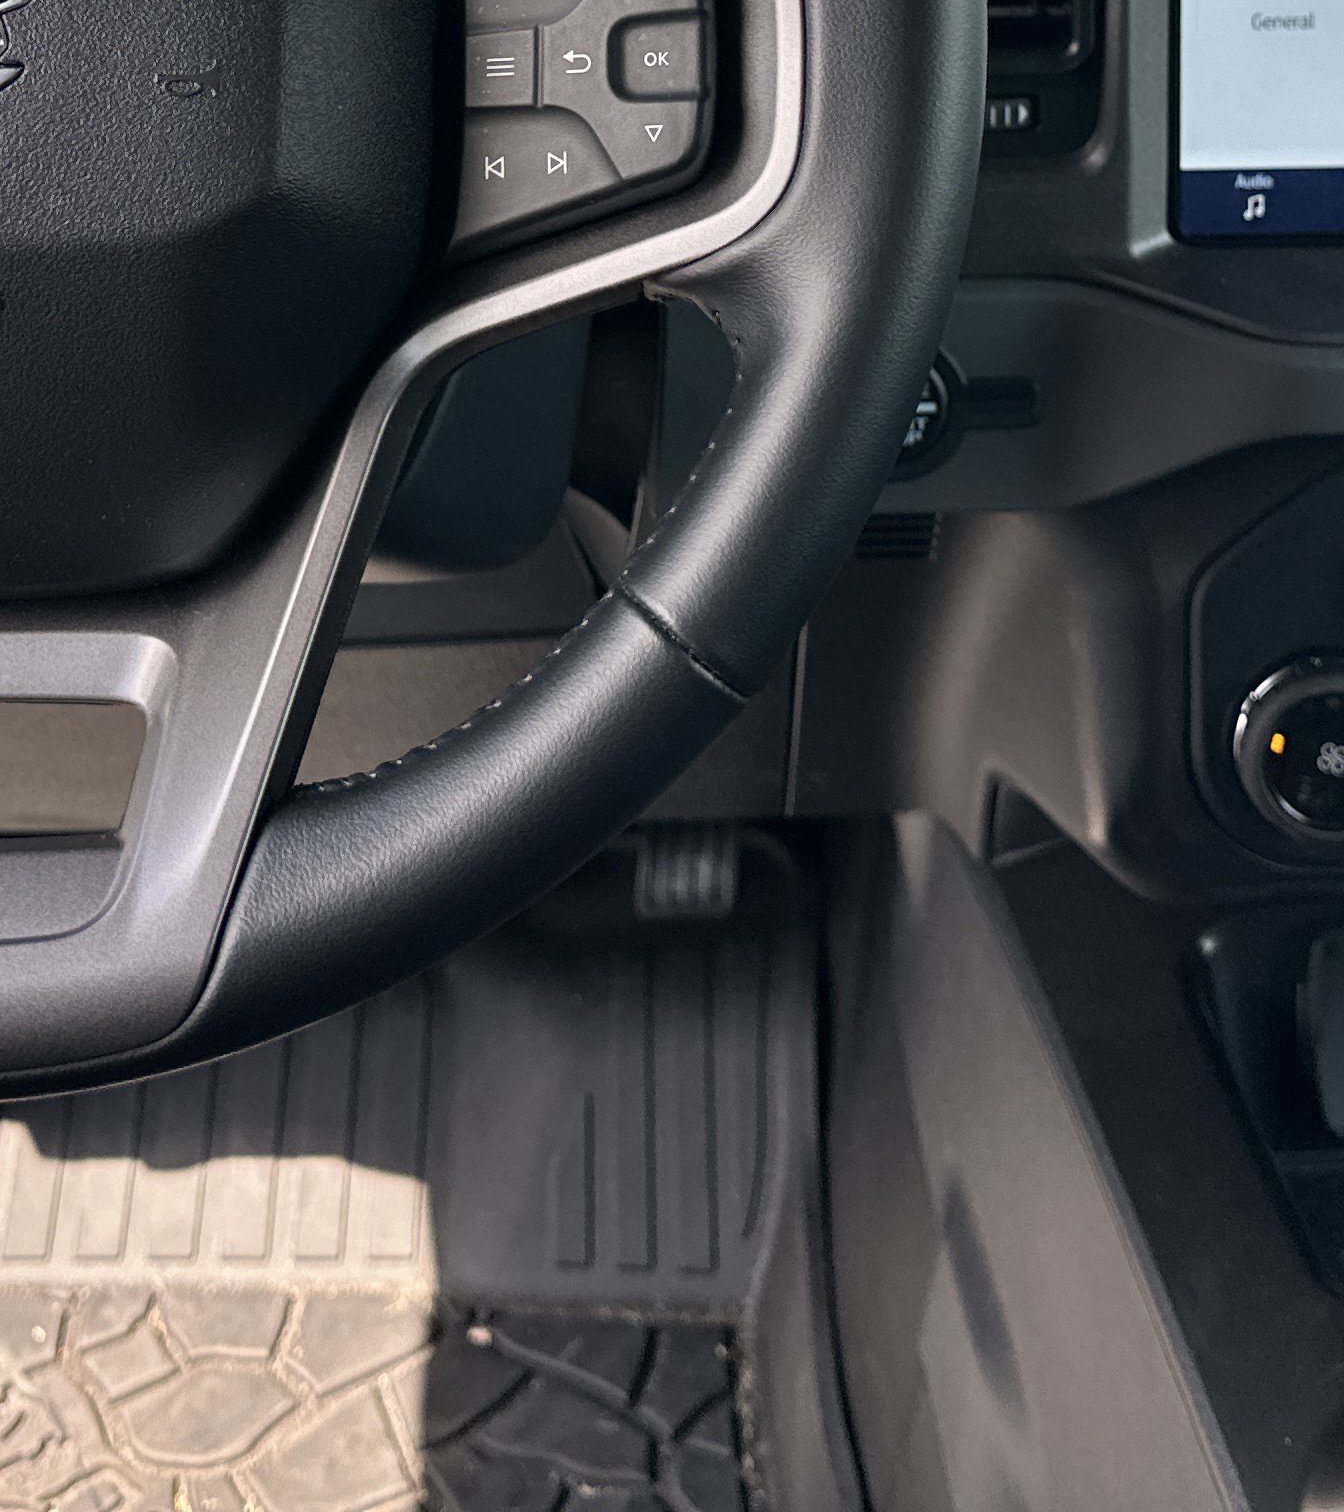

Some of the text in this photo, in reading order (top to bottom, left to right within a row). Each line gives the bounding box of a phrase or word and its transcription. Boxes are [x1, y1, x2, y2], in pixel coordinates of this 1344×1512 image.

[1251, 11, 1316, 31] General
[643, 51, 670, 67] OK
[1234, 172, 1275, 190] Audio
